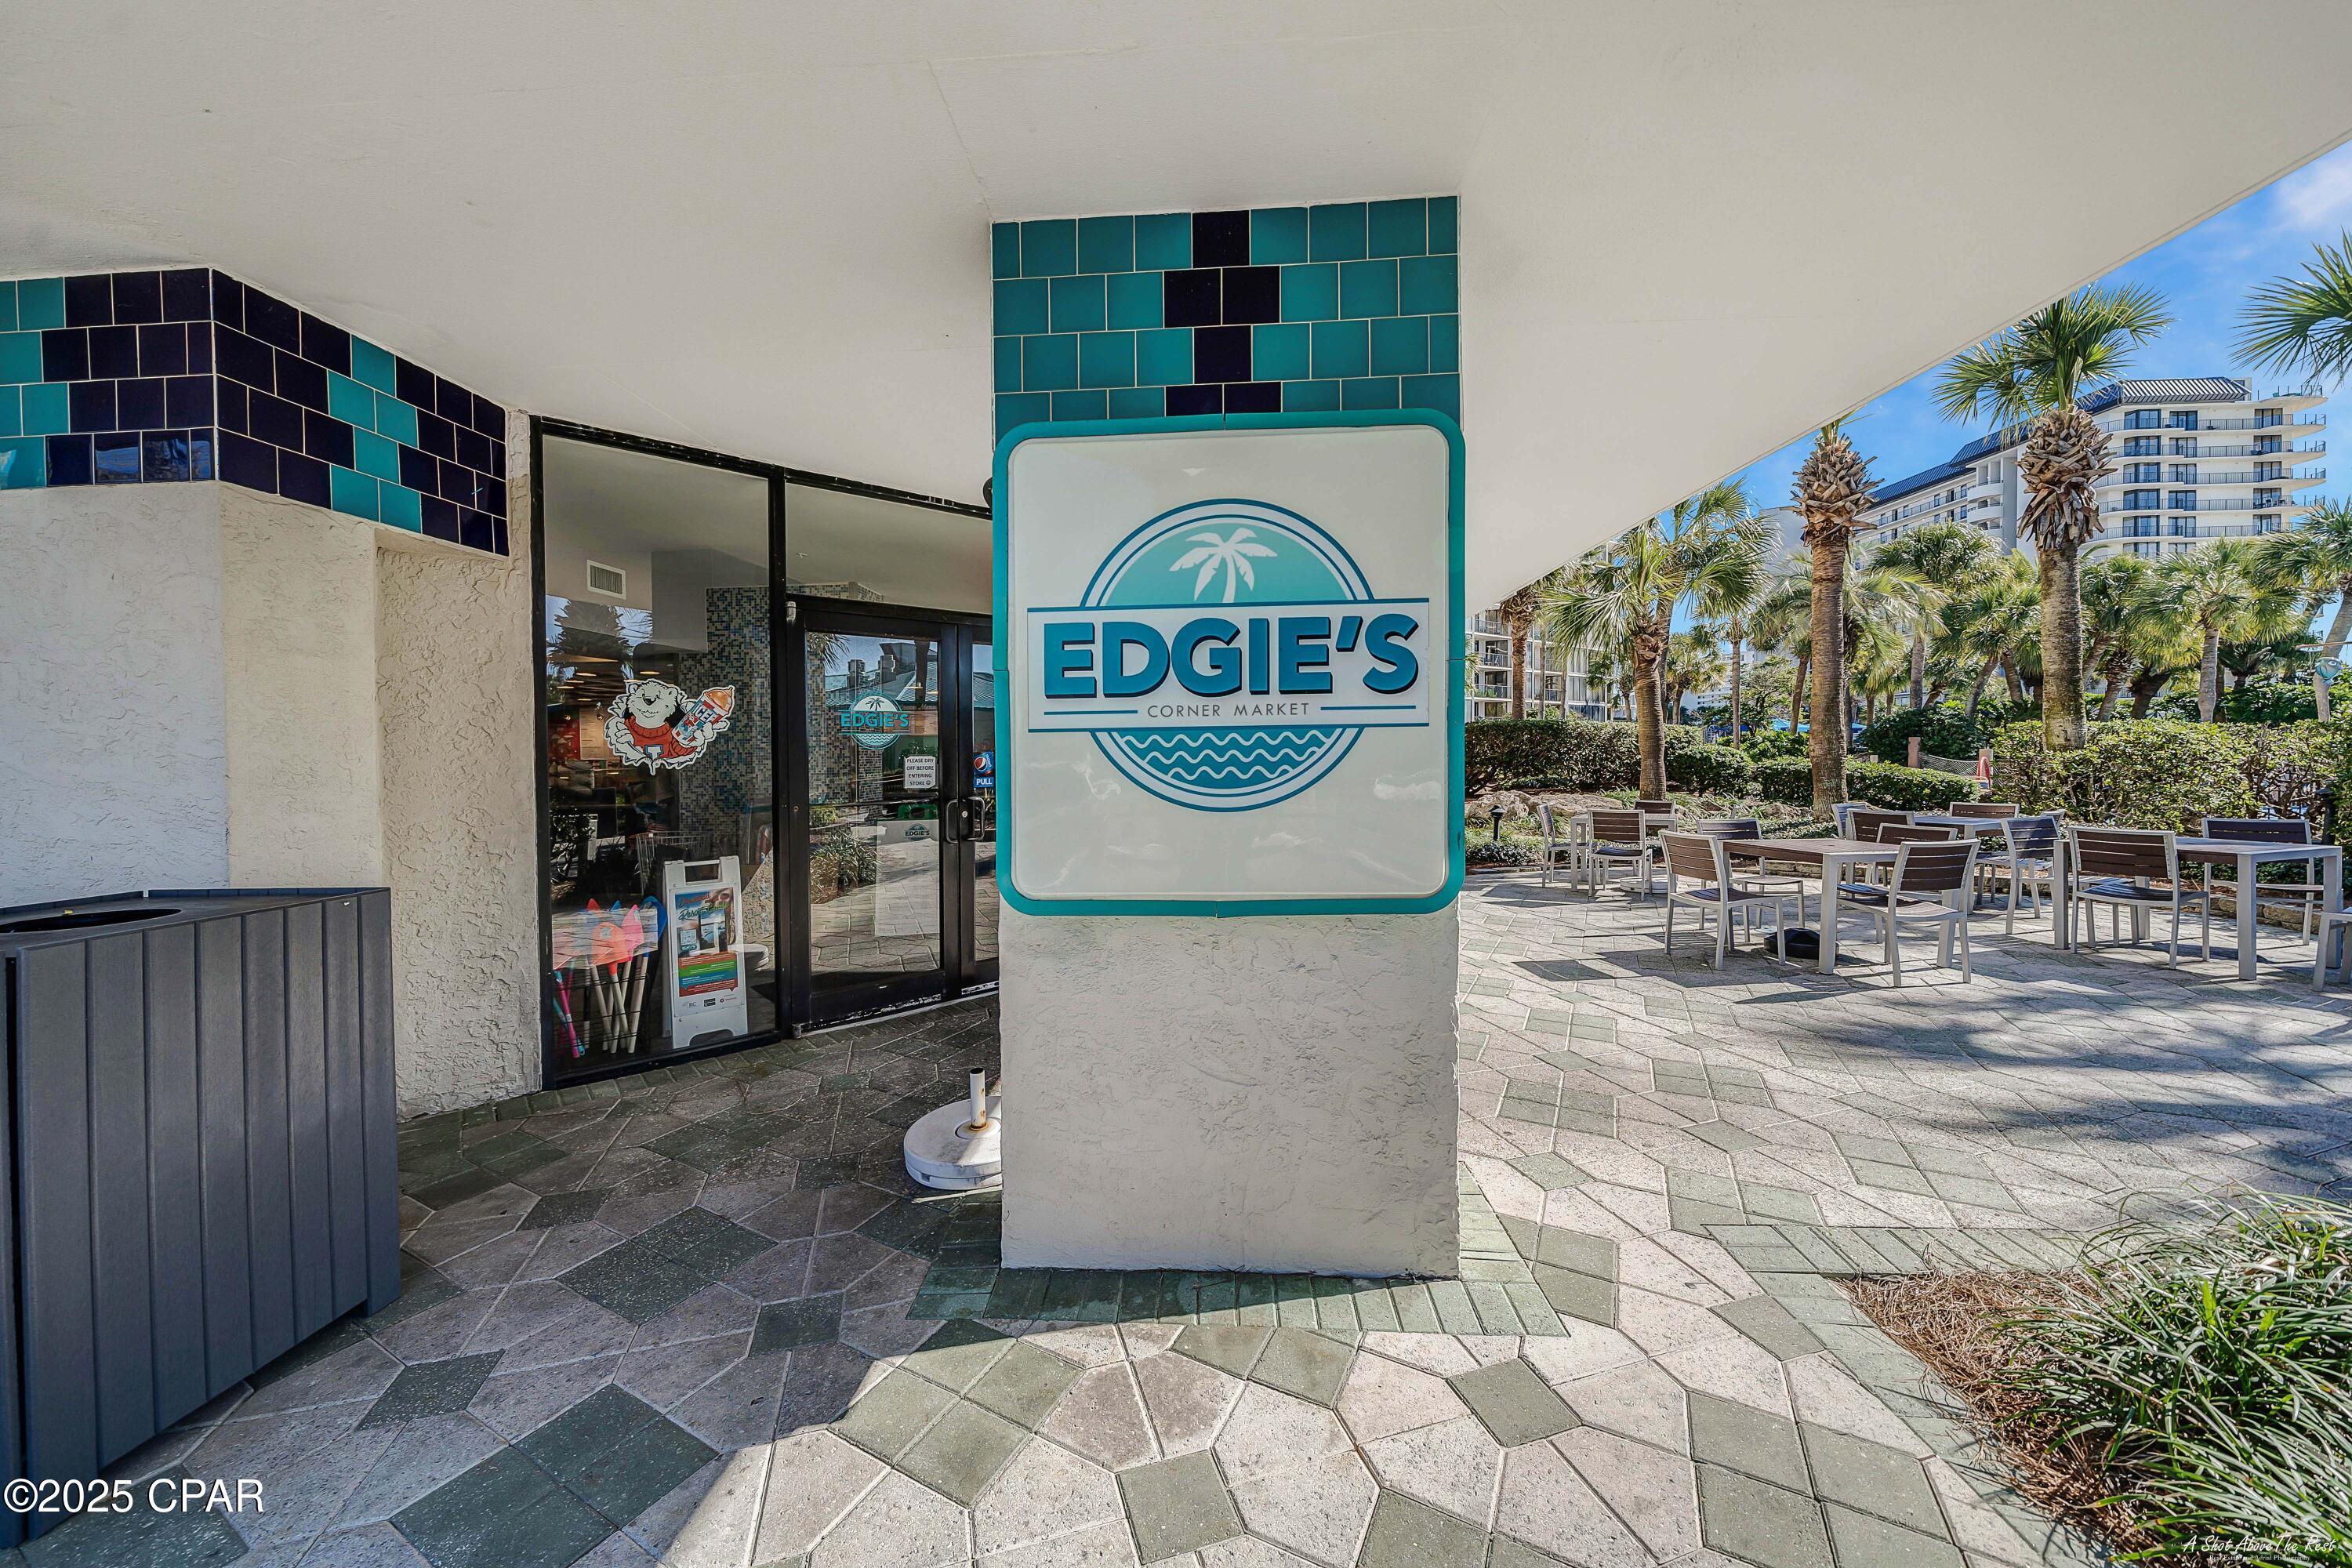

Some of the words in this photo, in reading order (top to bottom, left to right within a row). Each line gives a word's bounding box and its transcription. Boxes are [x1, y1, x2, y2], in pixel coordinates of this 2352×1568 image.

[1044, 614, 1418, 699] EDGIE'S
[1148, 704, 1221, 718] CORNER
[1234, 702, 1309, 717] MARKET
[840, 713, 909, 728] EDGIE'S
